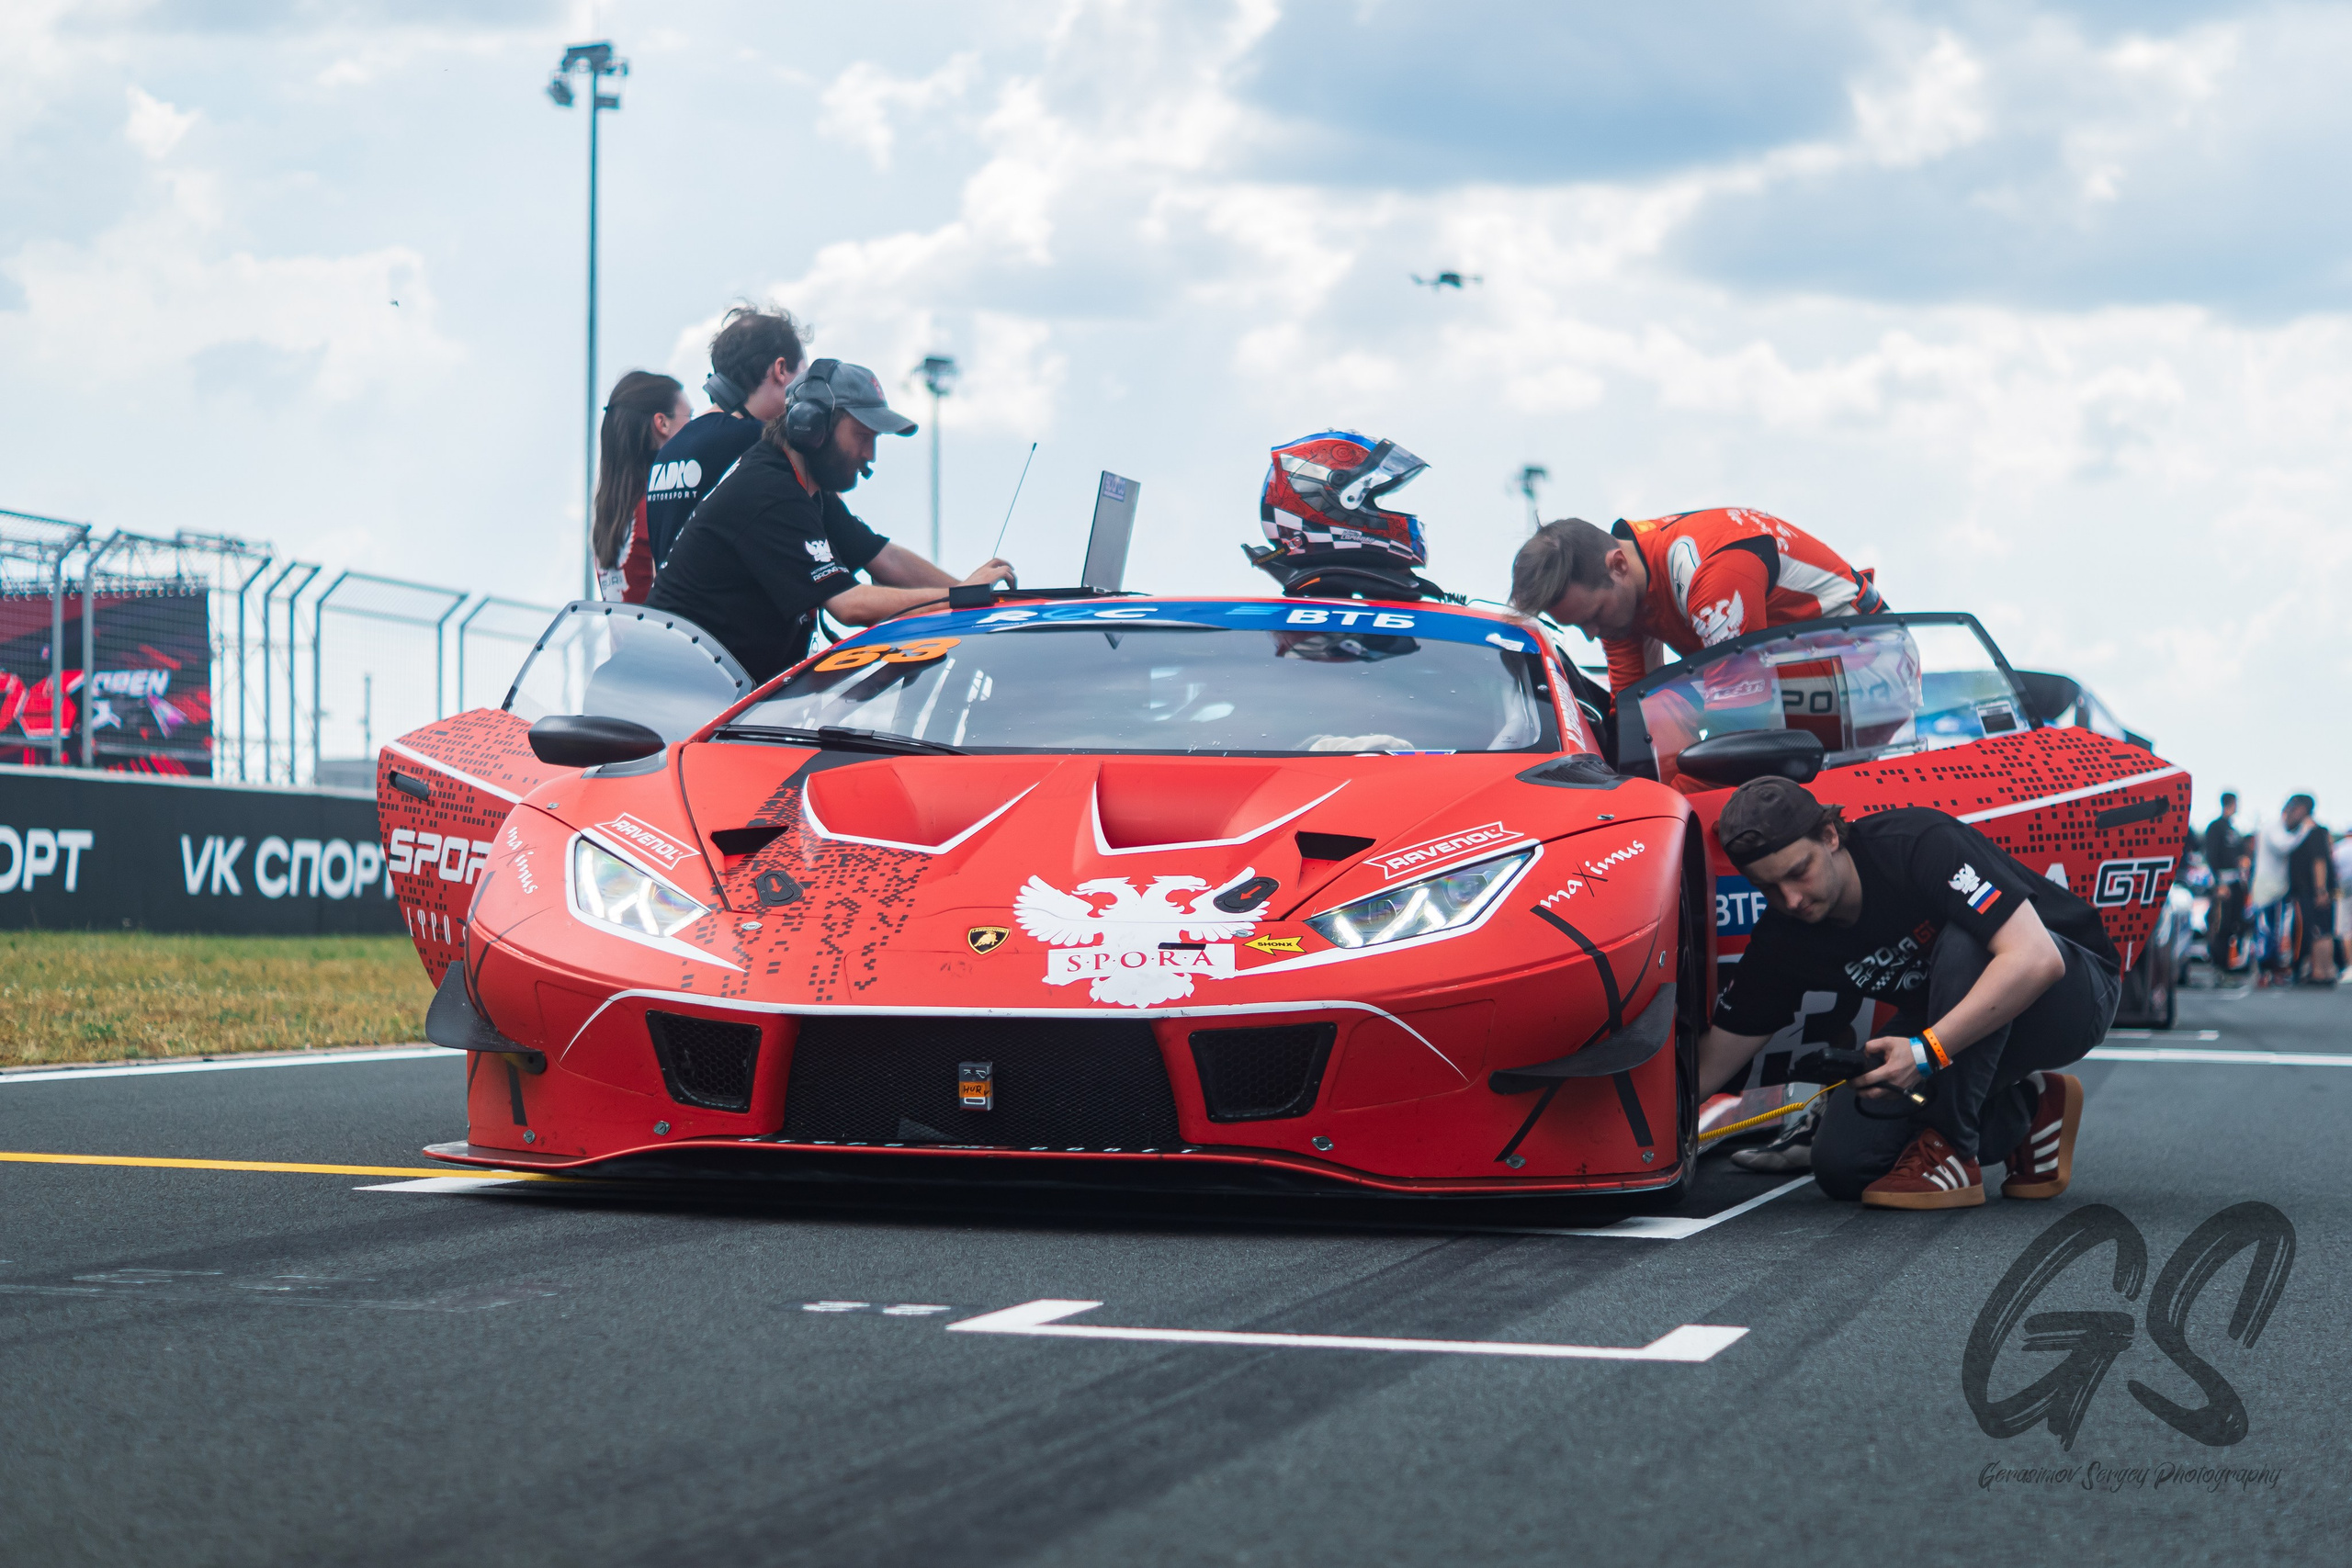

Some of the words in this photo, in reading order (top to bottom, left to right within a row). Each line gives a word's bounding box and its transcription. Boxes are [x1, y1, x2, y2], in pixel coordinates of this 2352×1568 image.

[647, 491, 697, 502] MOTORSPORT
[1286, 609, 1415, 628] ВТБ
[814, 637, 961, 671] 63
[612, 819, 682, 861] RAVENOL
[1385, 829, 1504, 871] RAVENOL
[181, 833, 246, 896] VK
[2093, 856, 2174, 908] GT
